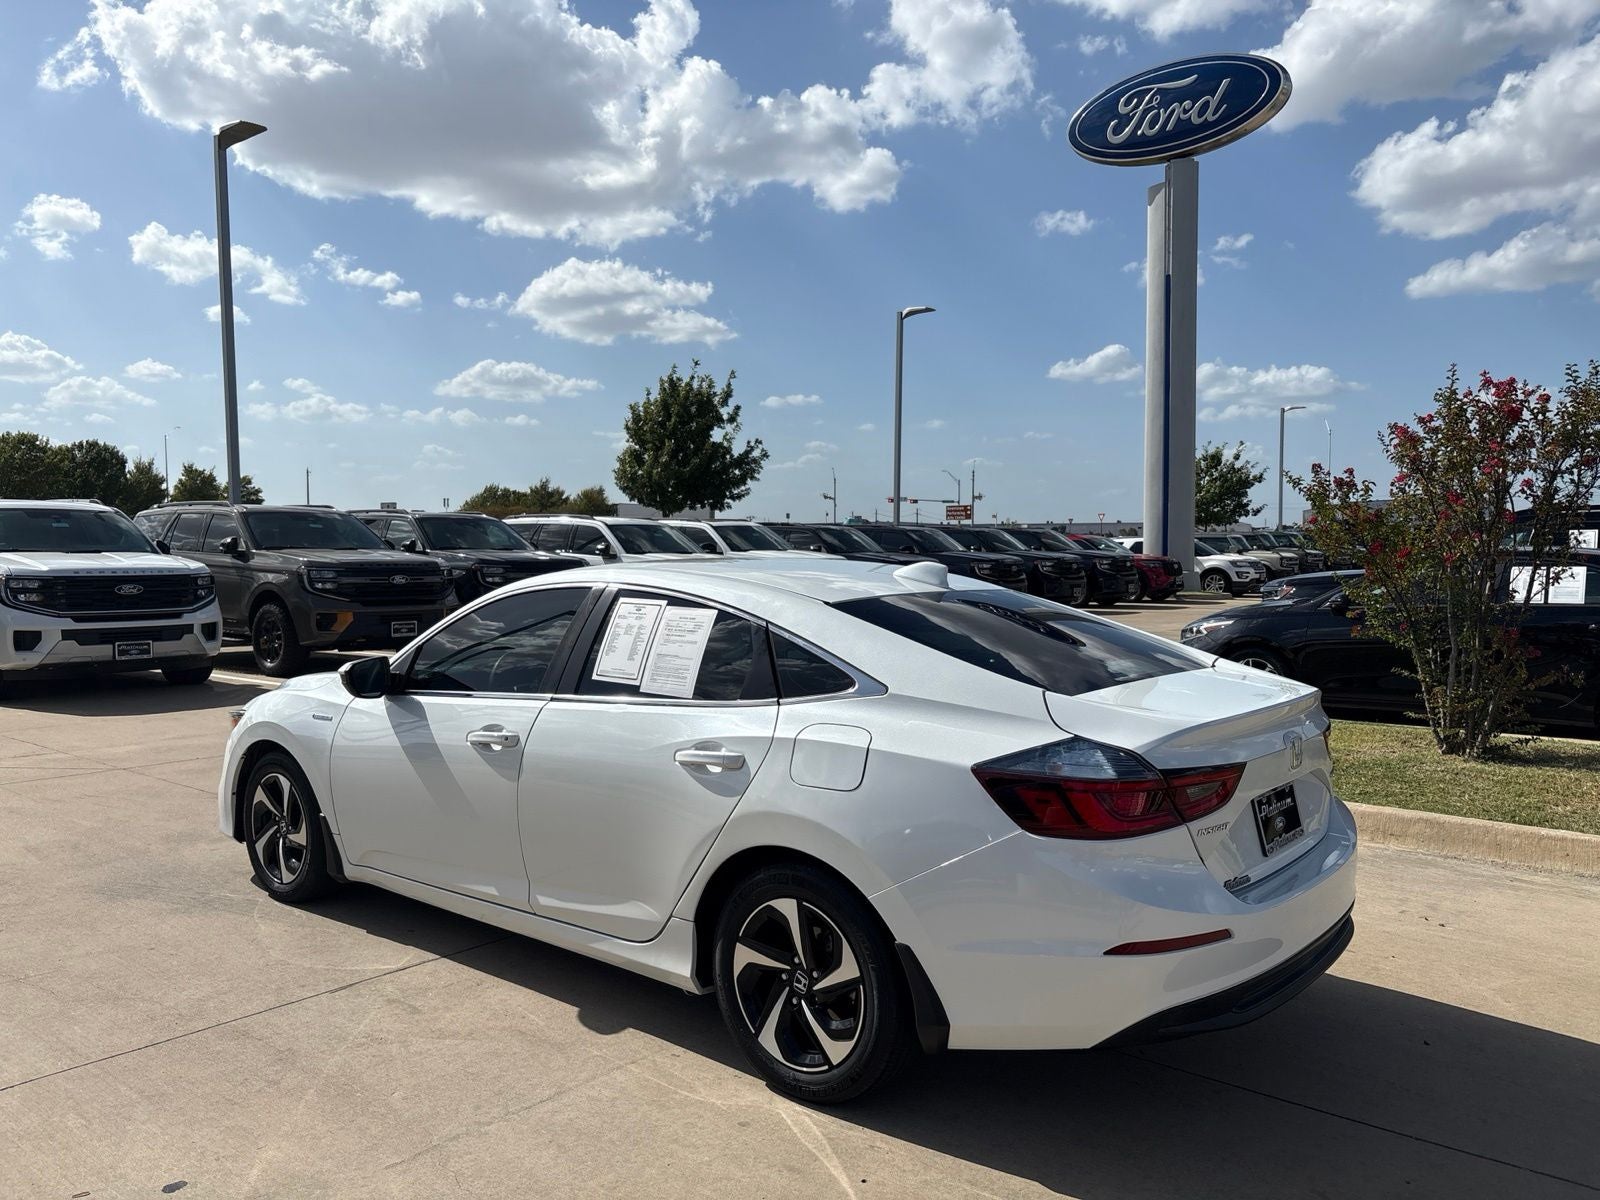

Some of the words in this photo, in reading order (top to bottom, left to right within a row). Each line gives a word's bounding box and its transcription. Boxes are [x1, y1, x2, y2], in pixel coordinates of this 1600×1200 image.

[1106, 74, 1231, 144] Ford
[120, 585, 139, 593] Ford
[1260, 797, 1295, 820] Platinum
[1196, 822, 1230, 837] INSIGHT
